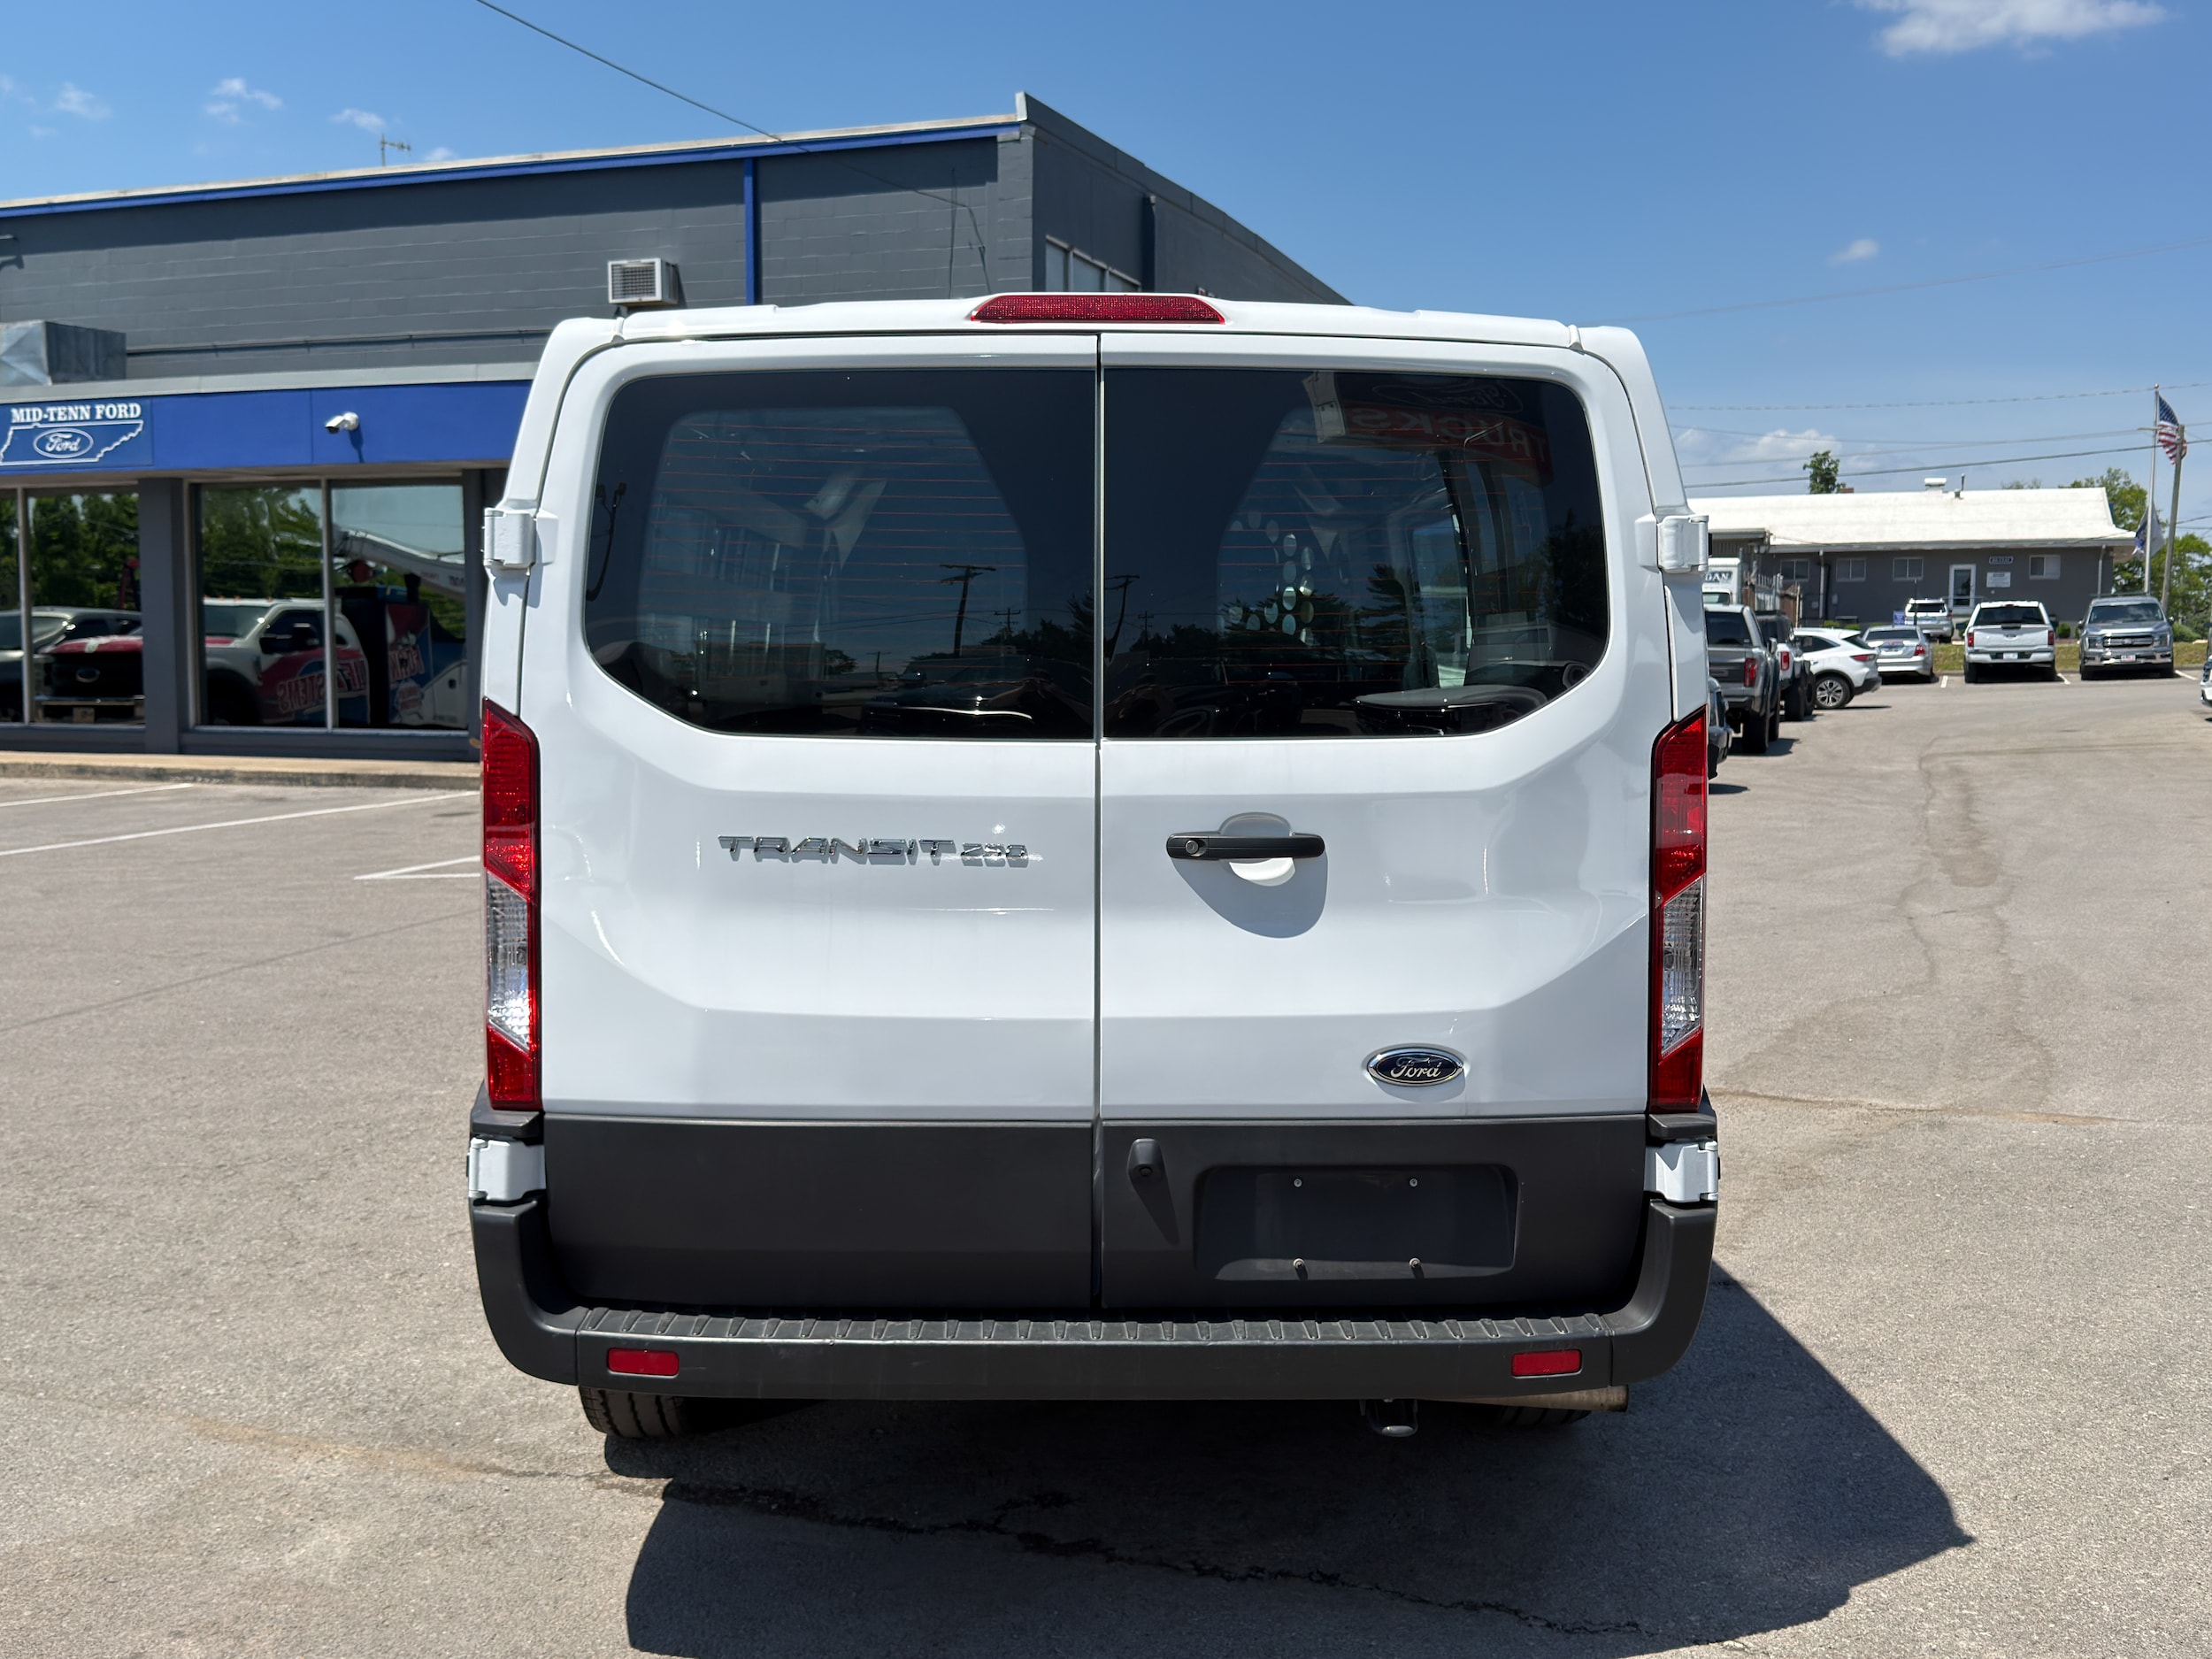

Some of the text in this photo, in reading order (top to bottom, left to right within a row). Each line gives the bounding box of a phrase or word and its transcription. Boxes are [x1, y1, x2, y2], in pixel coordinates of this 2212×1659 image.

[11, 403, 142, 423] MID-TENN FORD
[45, 432, 81, 452] Ford
[718, 834, 955, 858] TRANSIT
[1390, 1056, 1442, 1078] Ford
